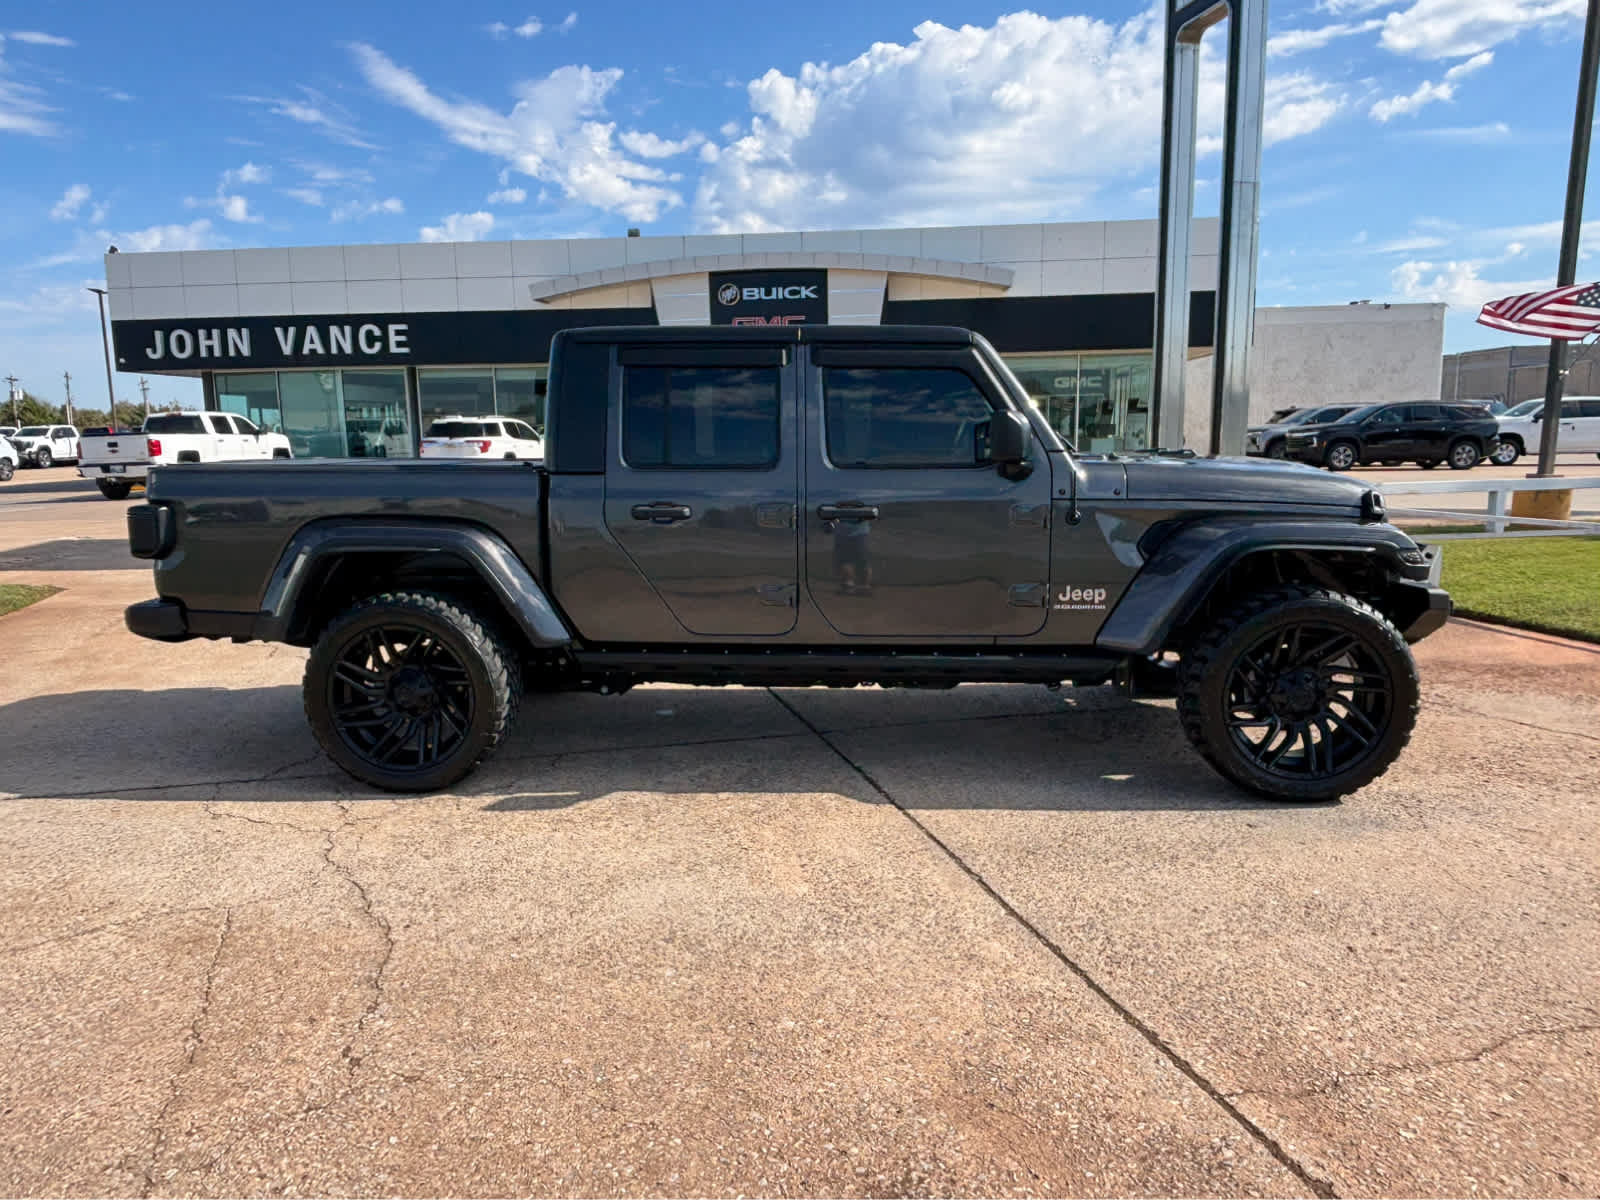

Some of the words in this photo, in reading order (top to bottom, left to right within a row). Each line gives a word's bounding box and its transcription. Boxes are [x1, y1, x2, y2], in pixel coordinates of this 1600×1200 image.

[743, 286, 818, 300] BUICK
[146, 328, 251, 359] JOHN
[274, 324, 411, 356] VANCE
[1054, 376, 1102, 388] GMC
[1058, 585, 1106, 603] Jeep
